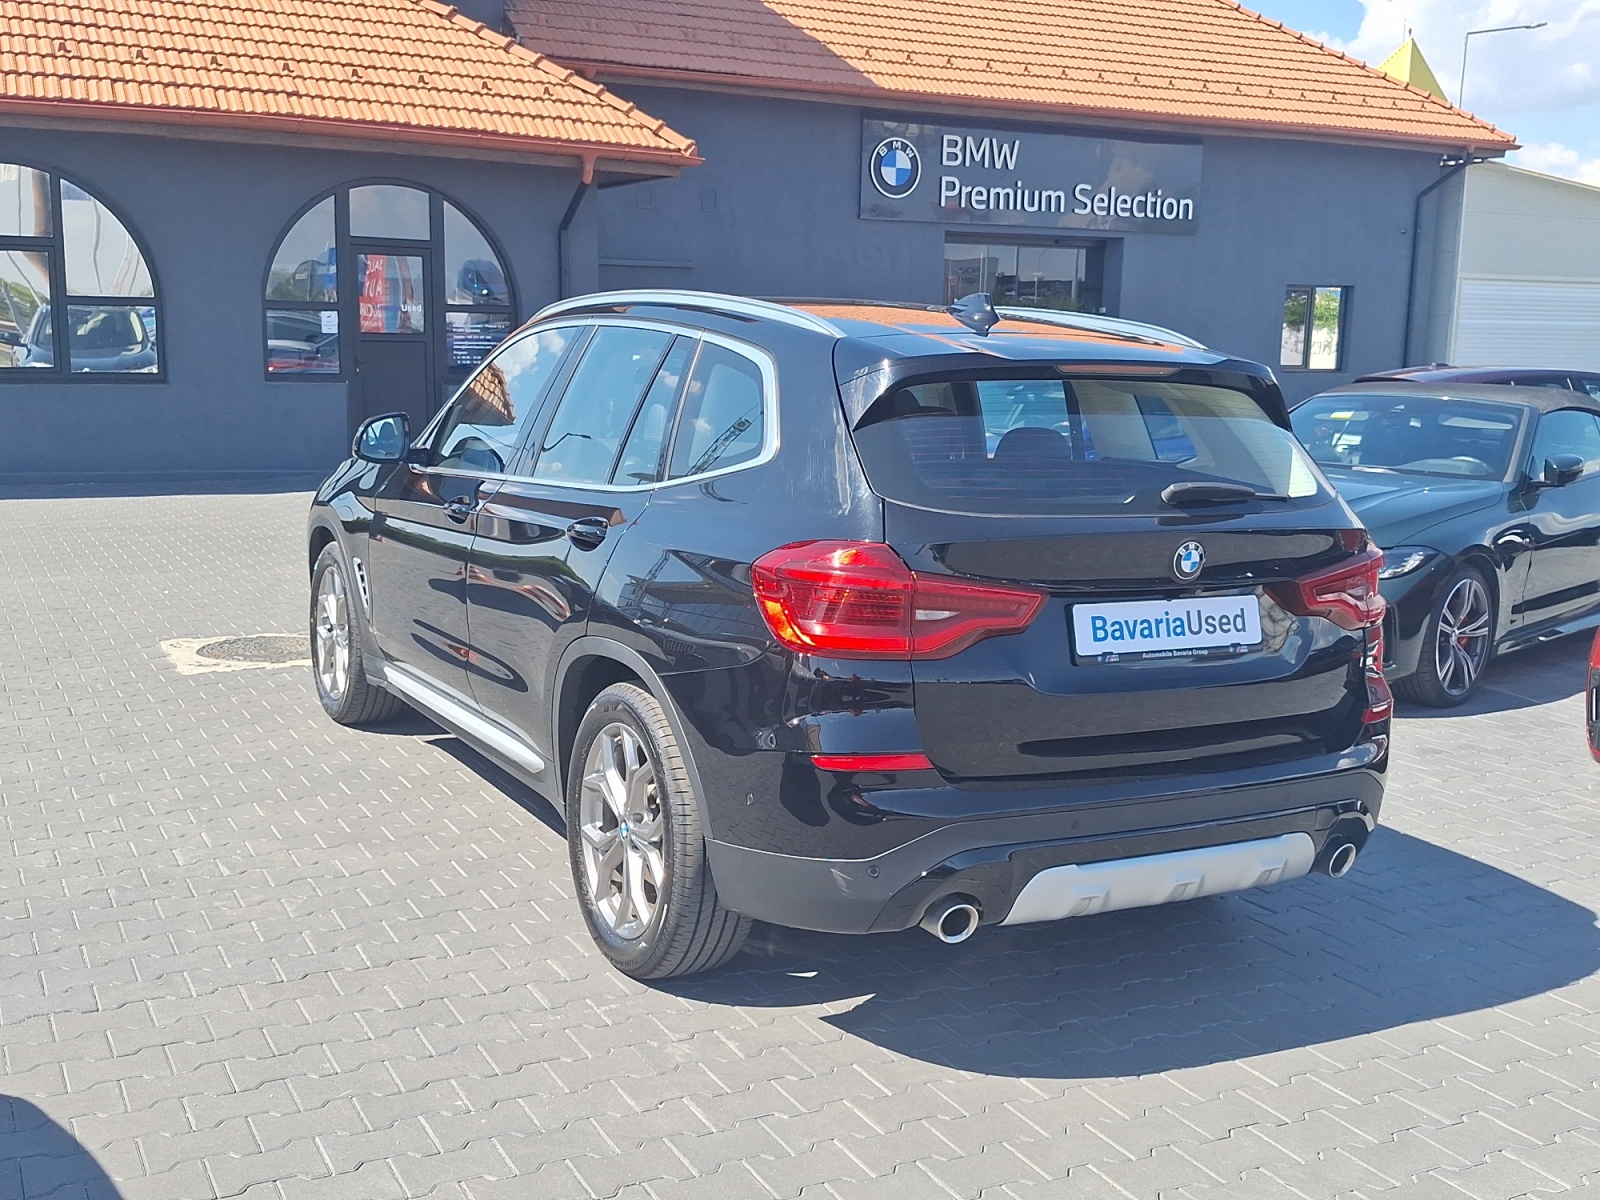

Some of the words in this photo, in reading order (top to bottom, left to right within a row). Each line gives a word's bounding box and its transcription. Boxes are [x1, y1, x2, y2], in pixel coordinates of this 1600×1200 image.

[878, 140, 915, 158] BMW
[941, 134, 1020, 170] BMW
[939, 176, 1065, 213] Premium
[1073, 184, 1194, 221] Selection
[1091, 608, 1246, 643] BavariaUsed
[1142, 650, 1172, 659] Automobile
[1173, 649, 1192, 657] Bavaria
[1192, 648, 1208, 656] Group
